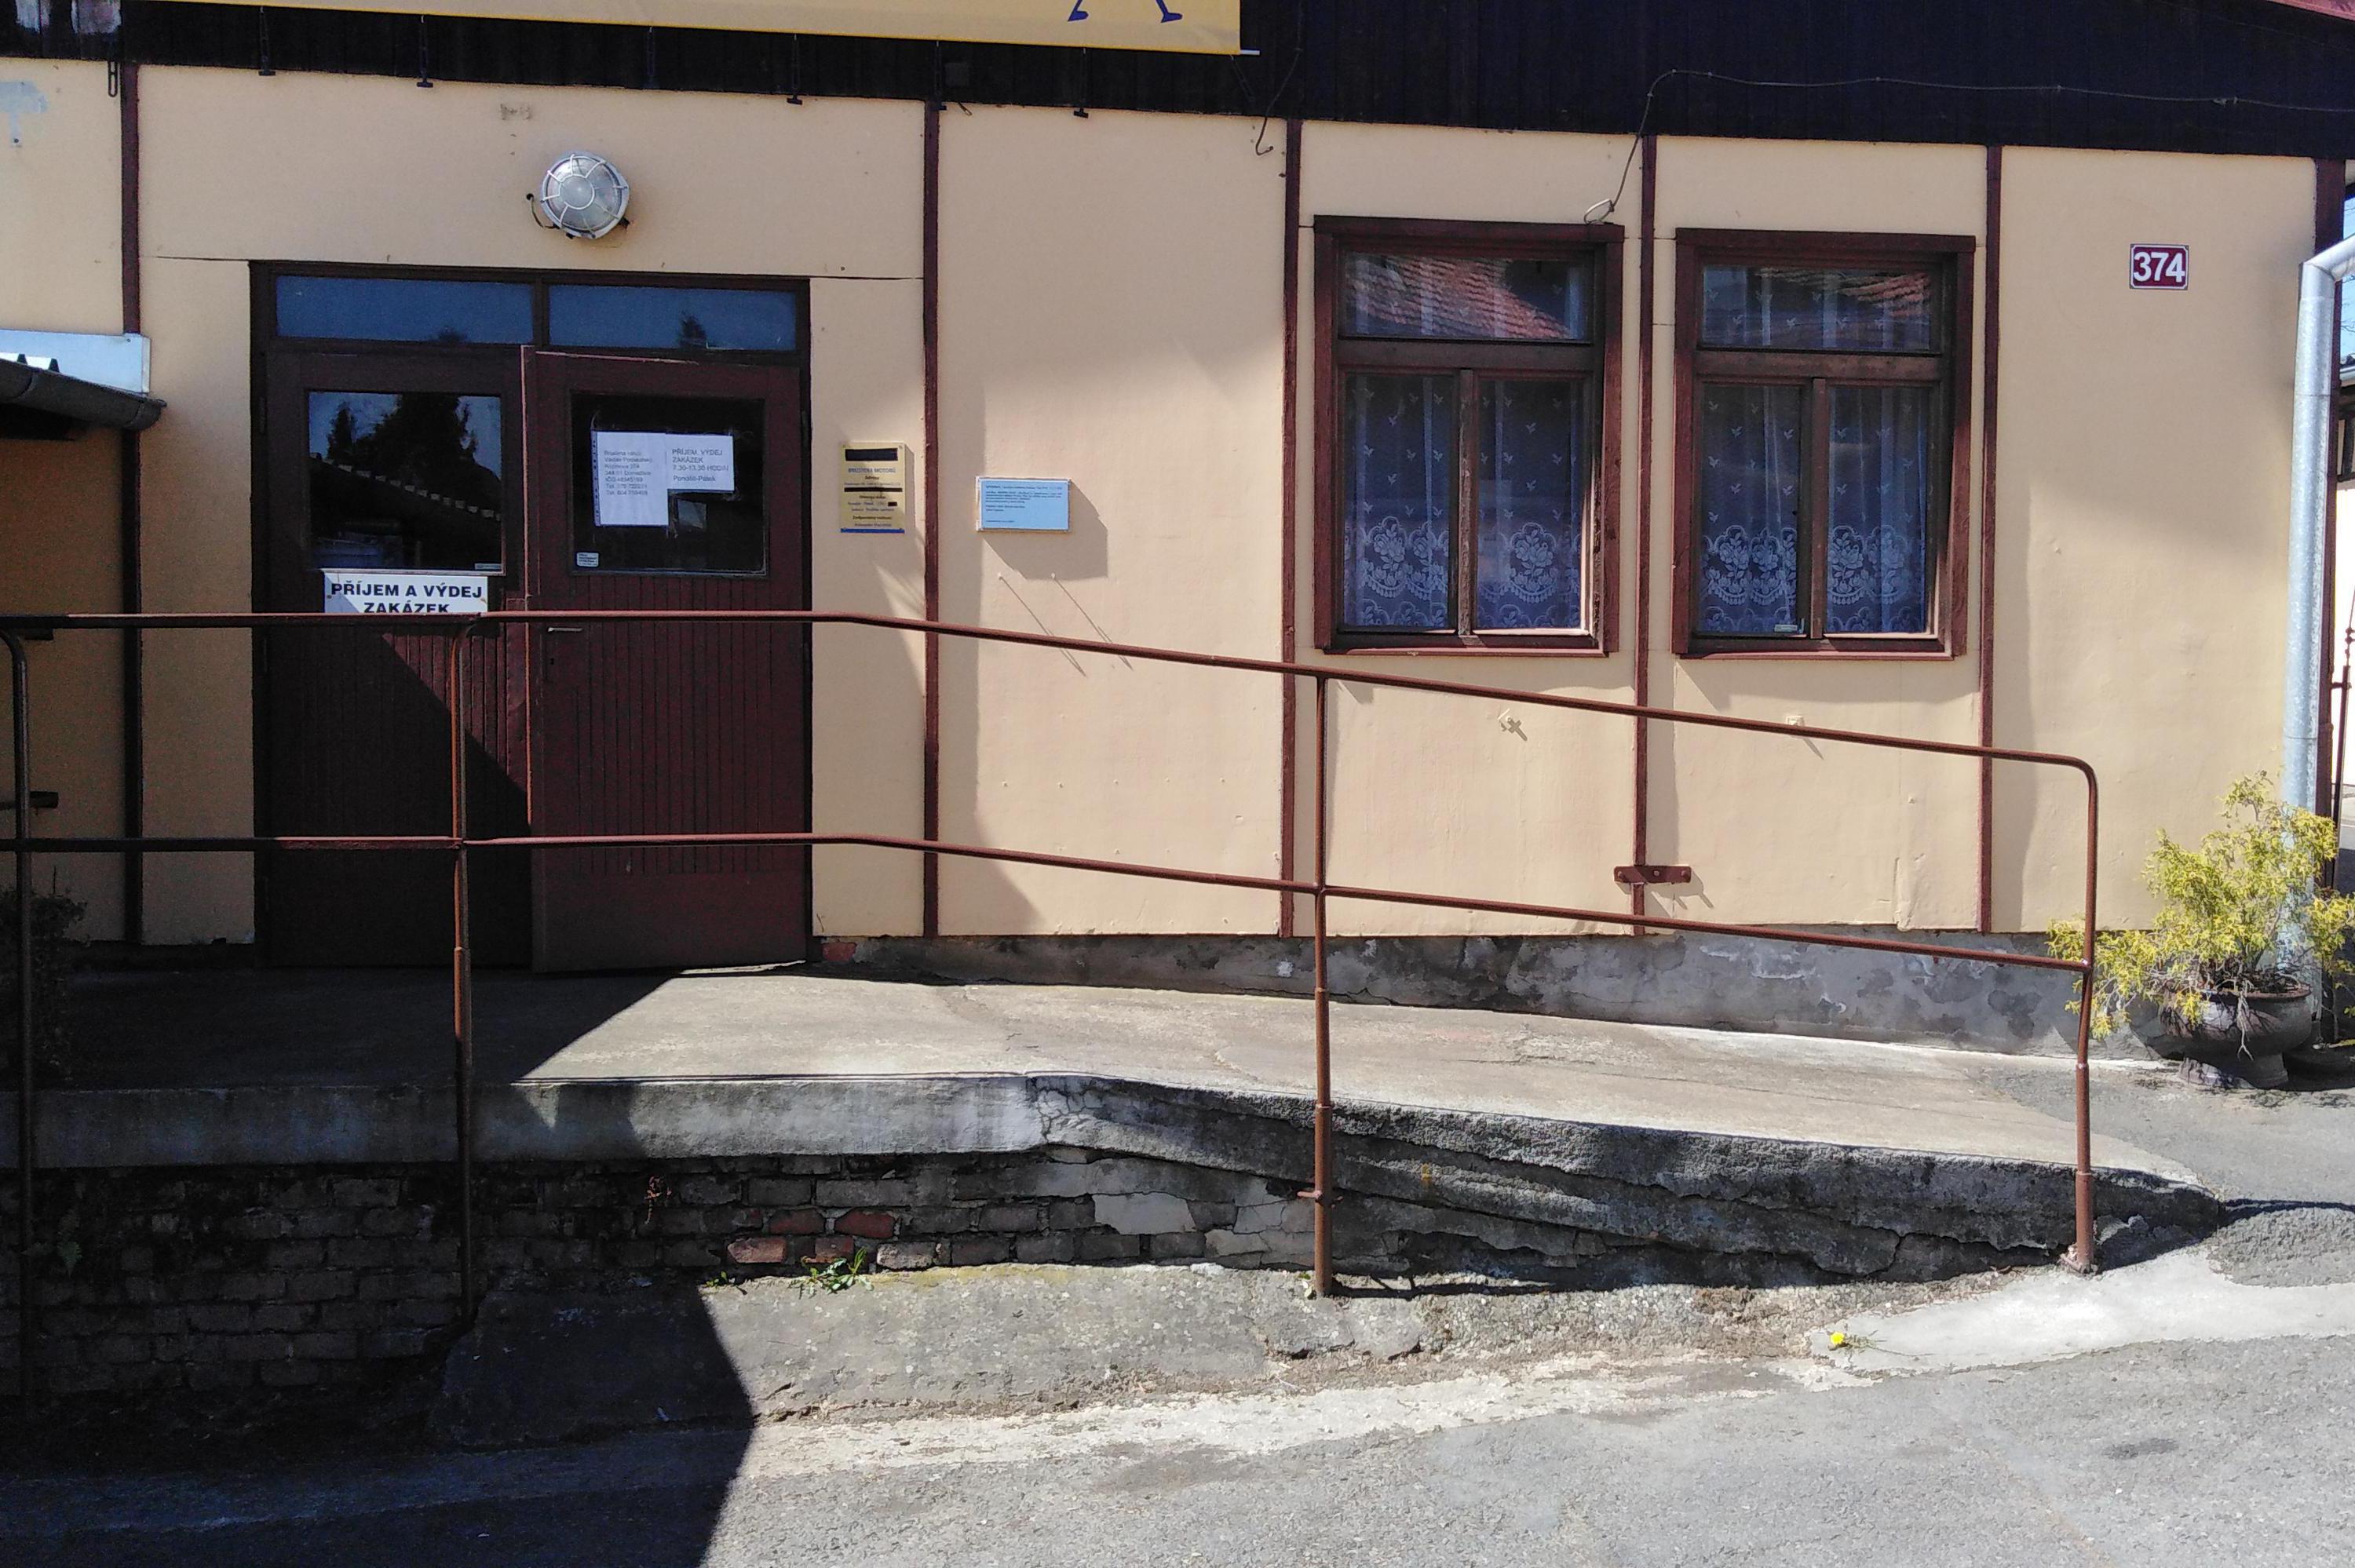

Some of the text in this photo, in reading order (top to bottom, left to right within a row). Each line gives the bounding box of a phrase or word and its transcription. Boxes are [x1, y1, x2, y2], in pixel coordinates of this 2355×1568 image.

[2134, 252, 2185, 283] 374
[331, 580, 483, 598] PŘÍJEM A VÝDEJ
[363, 600, 451, 613] ZAKÁZEK
